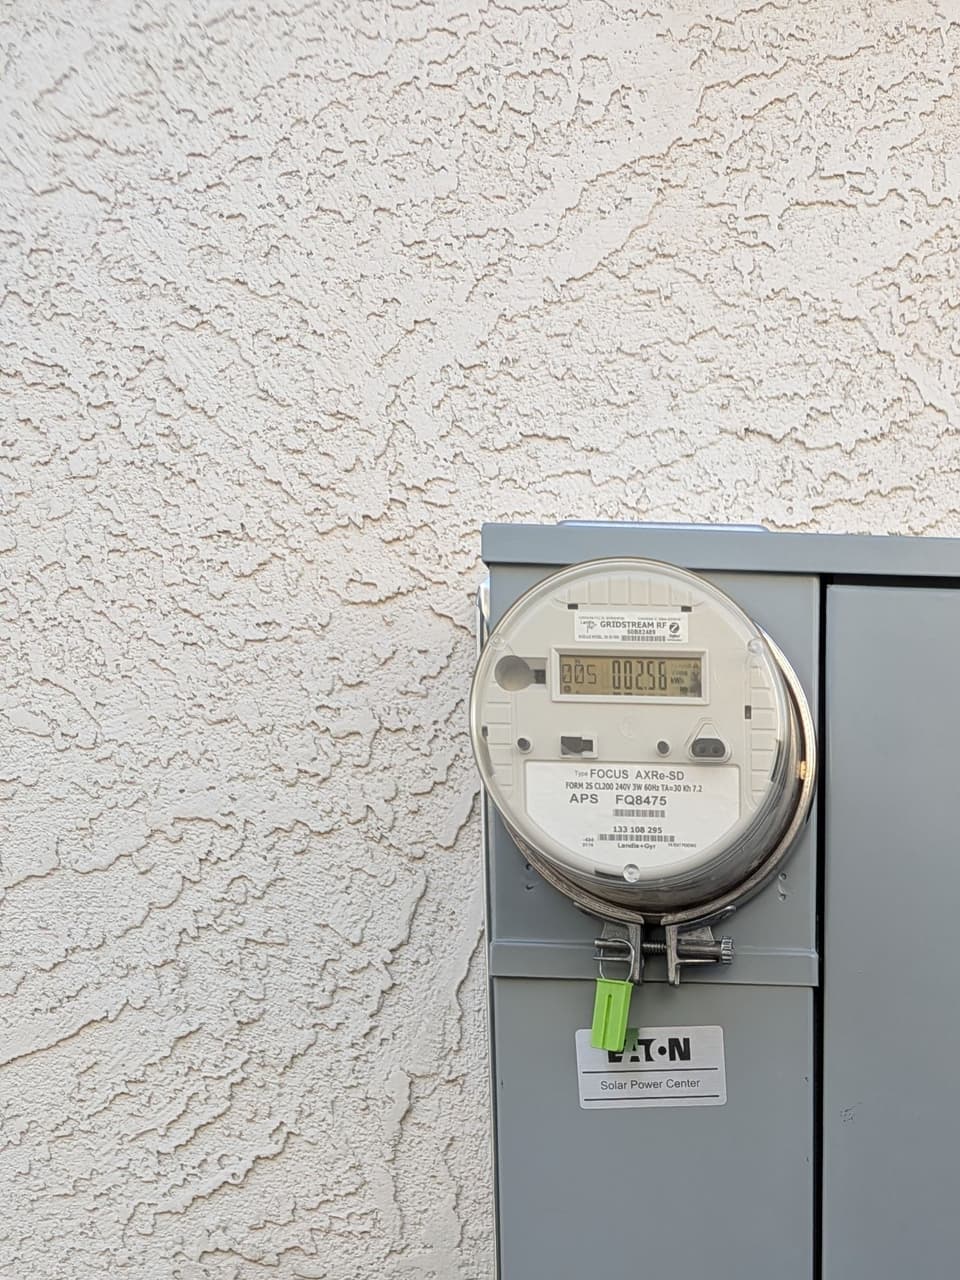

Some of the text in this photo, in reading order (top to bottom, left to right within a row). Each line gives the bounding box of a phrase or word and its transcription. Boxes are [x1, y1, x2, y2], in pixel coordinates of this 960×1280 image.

[600, 621, 655, 629] GRIDSTREAM
[575, 769, 685, 781] Type FOCUS AXRe-SD
[565, 782, 584, 790] FORM
[594, 782, 614, 791] CL200
[615, 782, 631, 791] 240V
[632, 783, 643, 791] 3W
[644, 783, 660, 792] 60Hz
[661, 784, 681, 792] TA=30
[683, 784, 691, 792] Kh
[693, 785, 703, 793] 7.2
[569, 793, 667, 806] APS FQ8475
[600, 1078, 701, 1091] Solar Power Center
